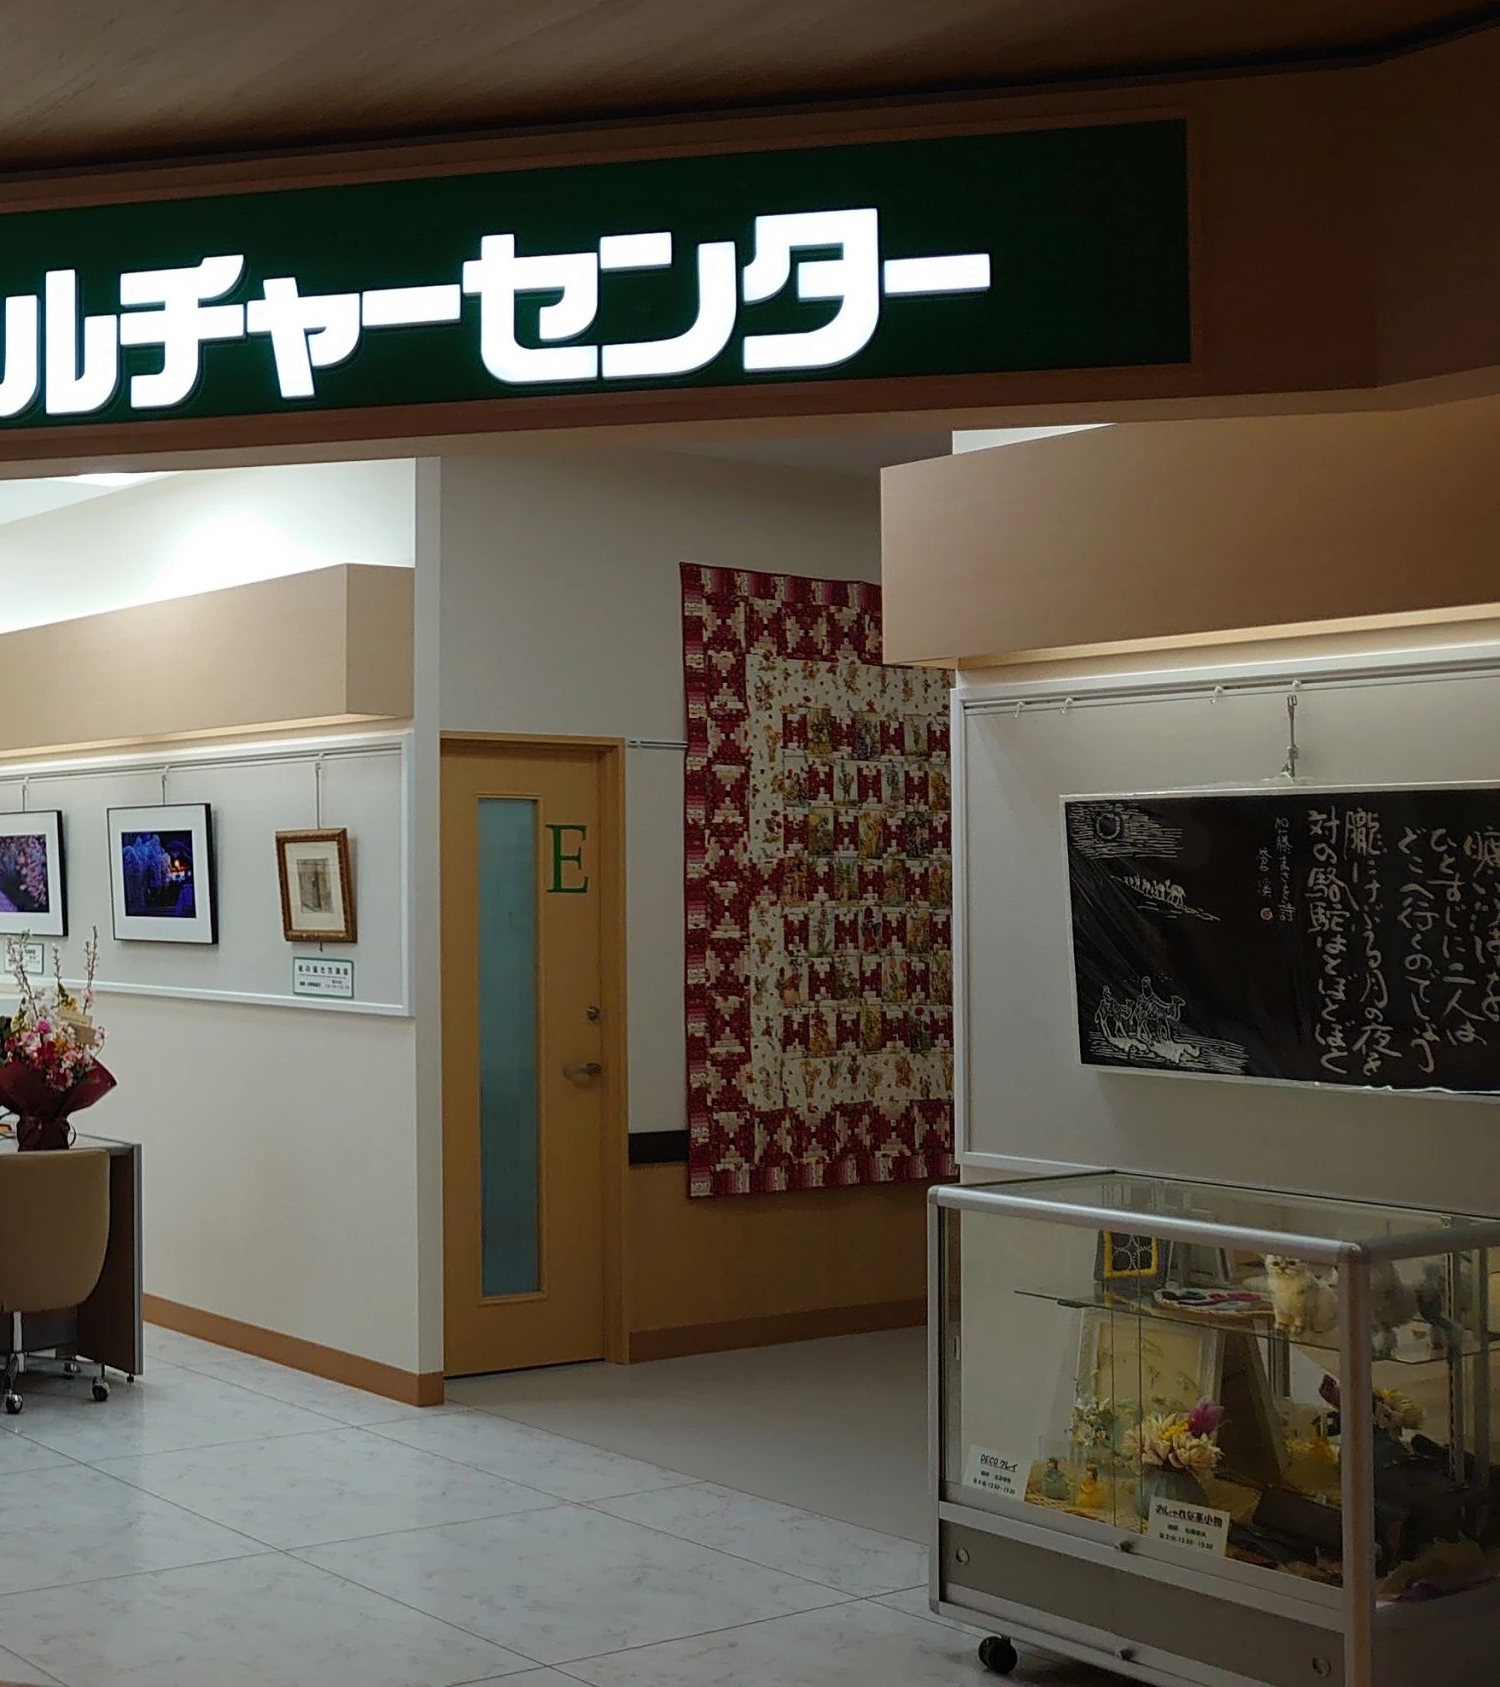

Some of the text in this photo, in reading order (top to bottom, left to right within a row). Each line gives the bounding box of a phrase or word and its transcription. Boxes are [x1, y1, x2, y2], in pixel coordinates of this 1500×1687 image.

[545, 824, 588, 893] E
[980, 1454, 1018, 1472] DECO クレイ
